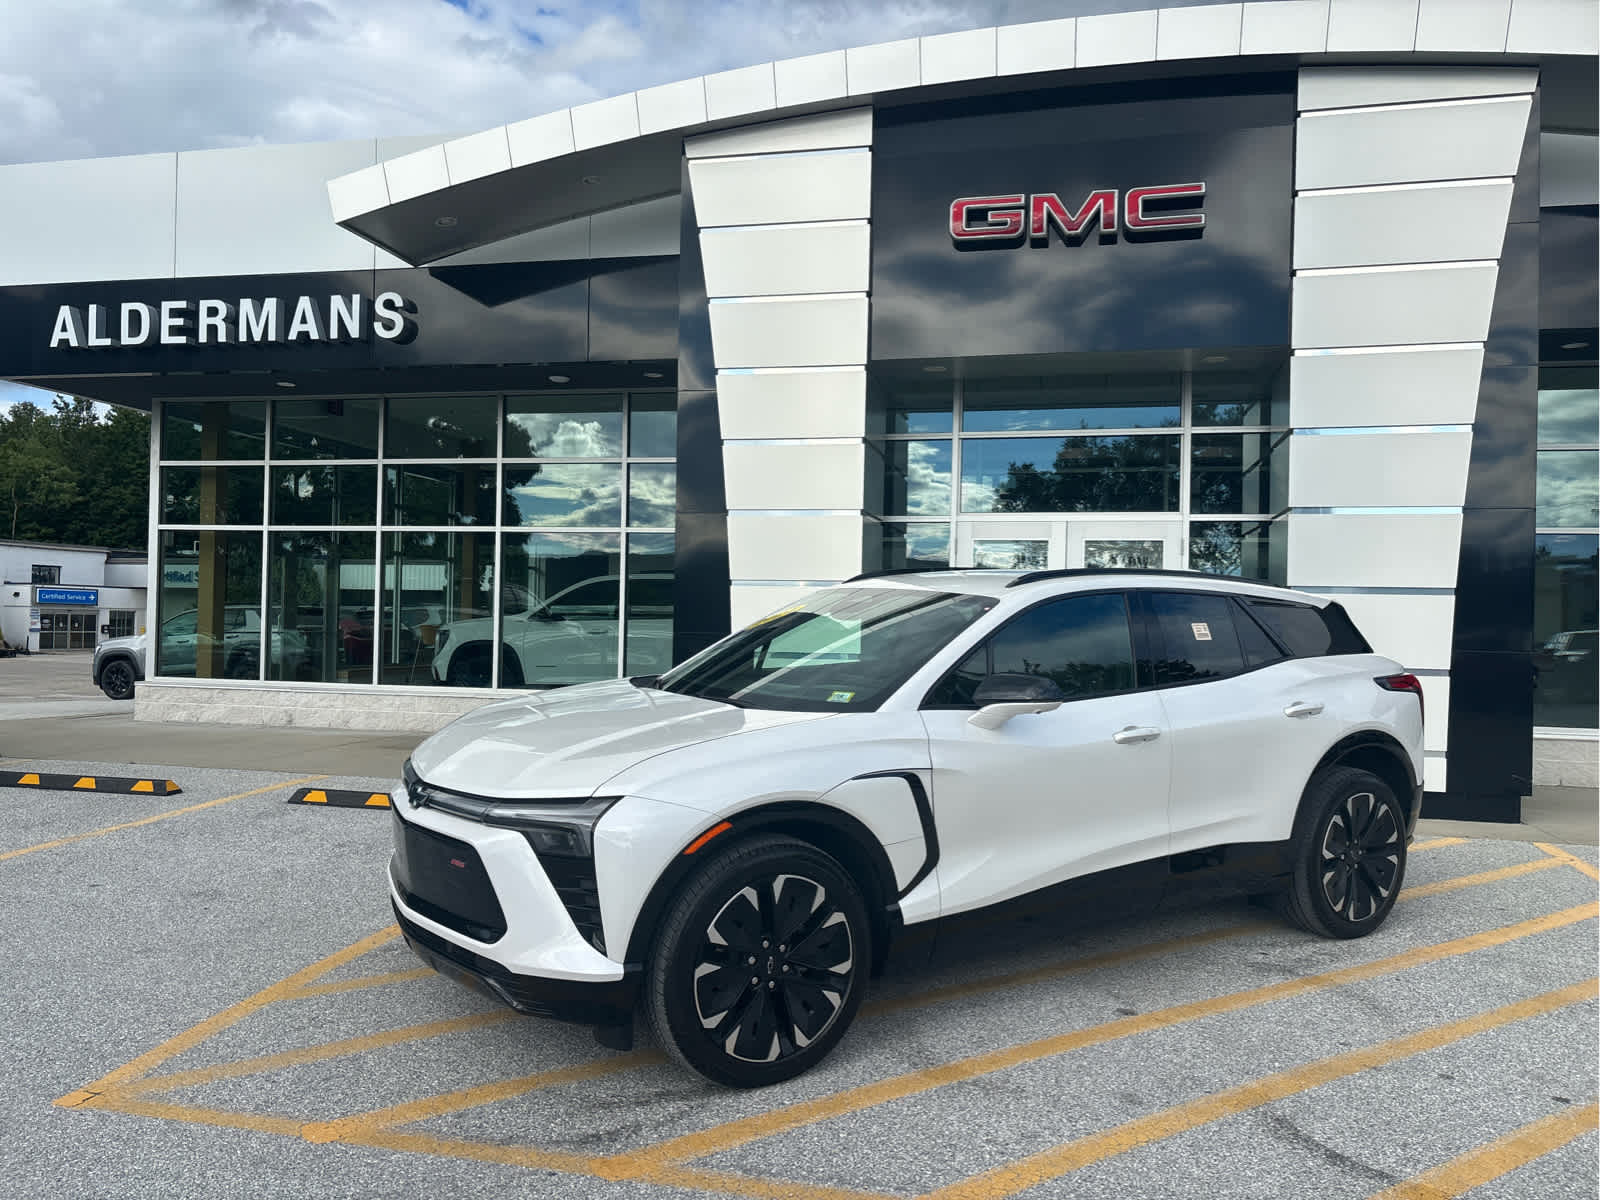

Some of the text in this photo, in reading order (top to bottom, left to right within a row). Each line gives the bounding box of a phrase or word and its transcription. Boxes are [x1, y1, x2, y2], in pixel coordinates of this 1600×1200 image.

[950, 182, 1206, 241] GMC
[49, 291, 405, 349] ALDERMANS
[66, 593, 87, 601] Service
